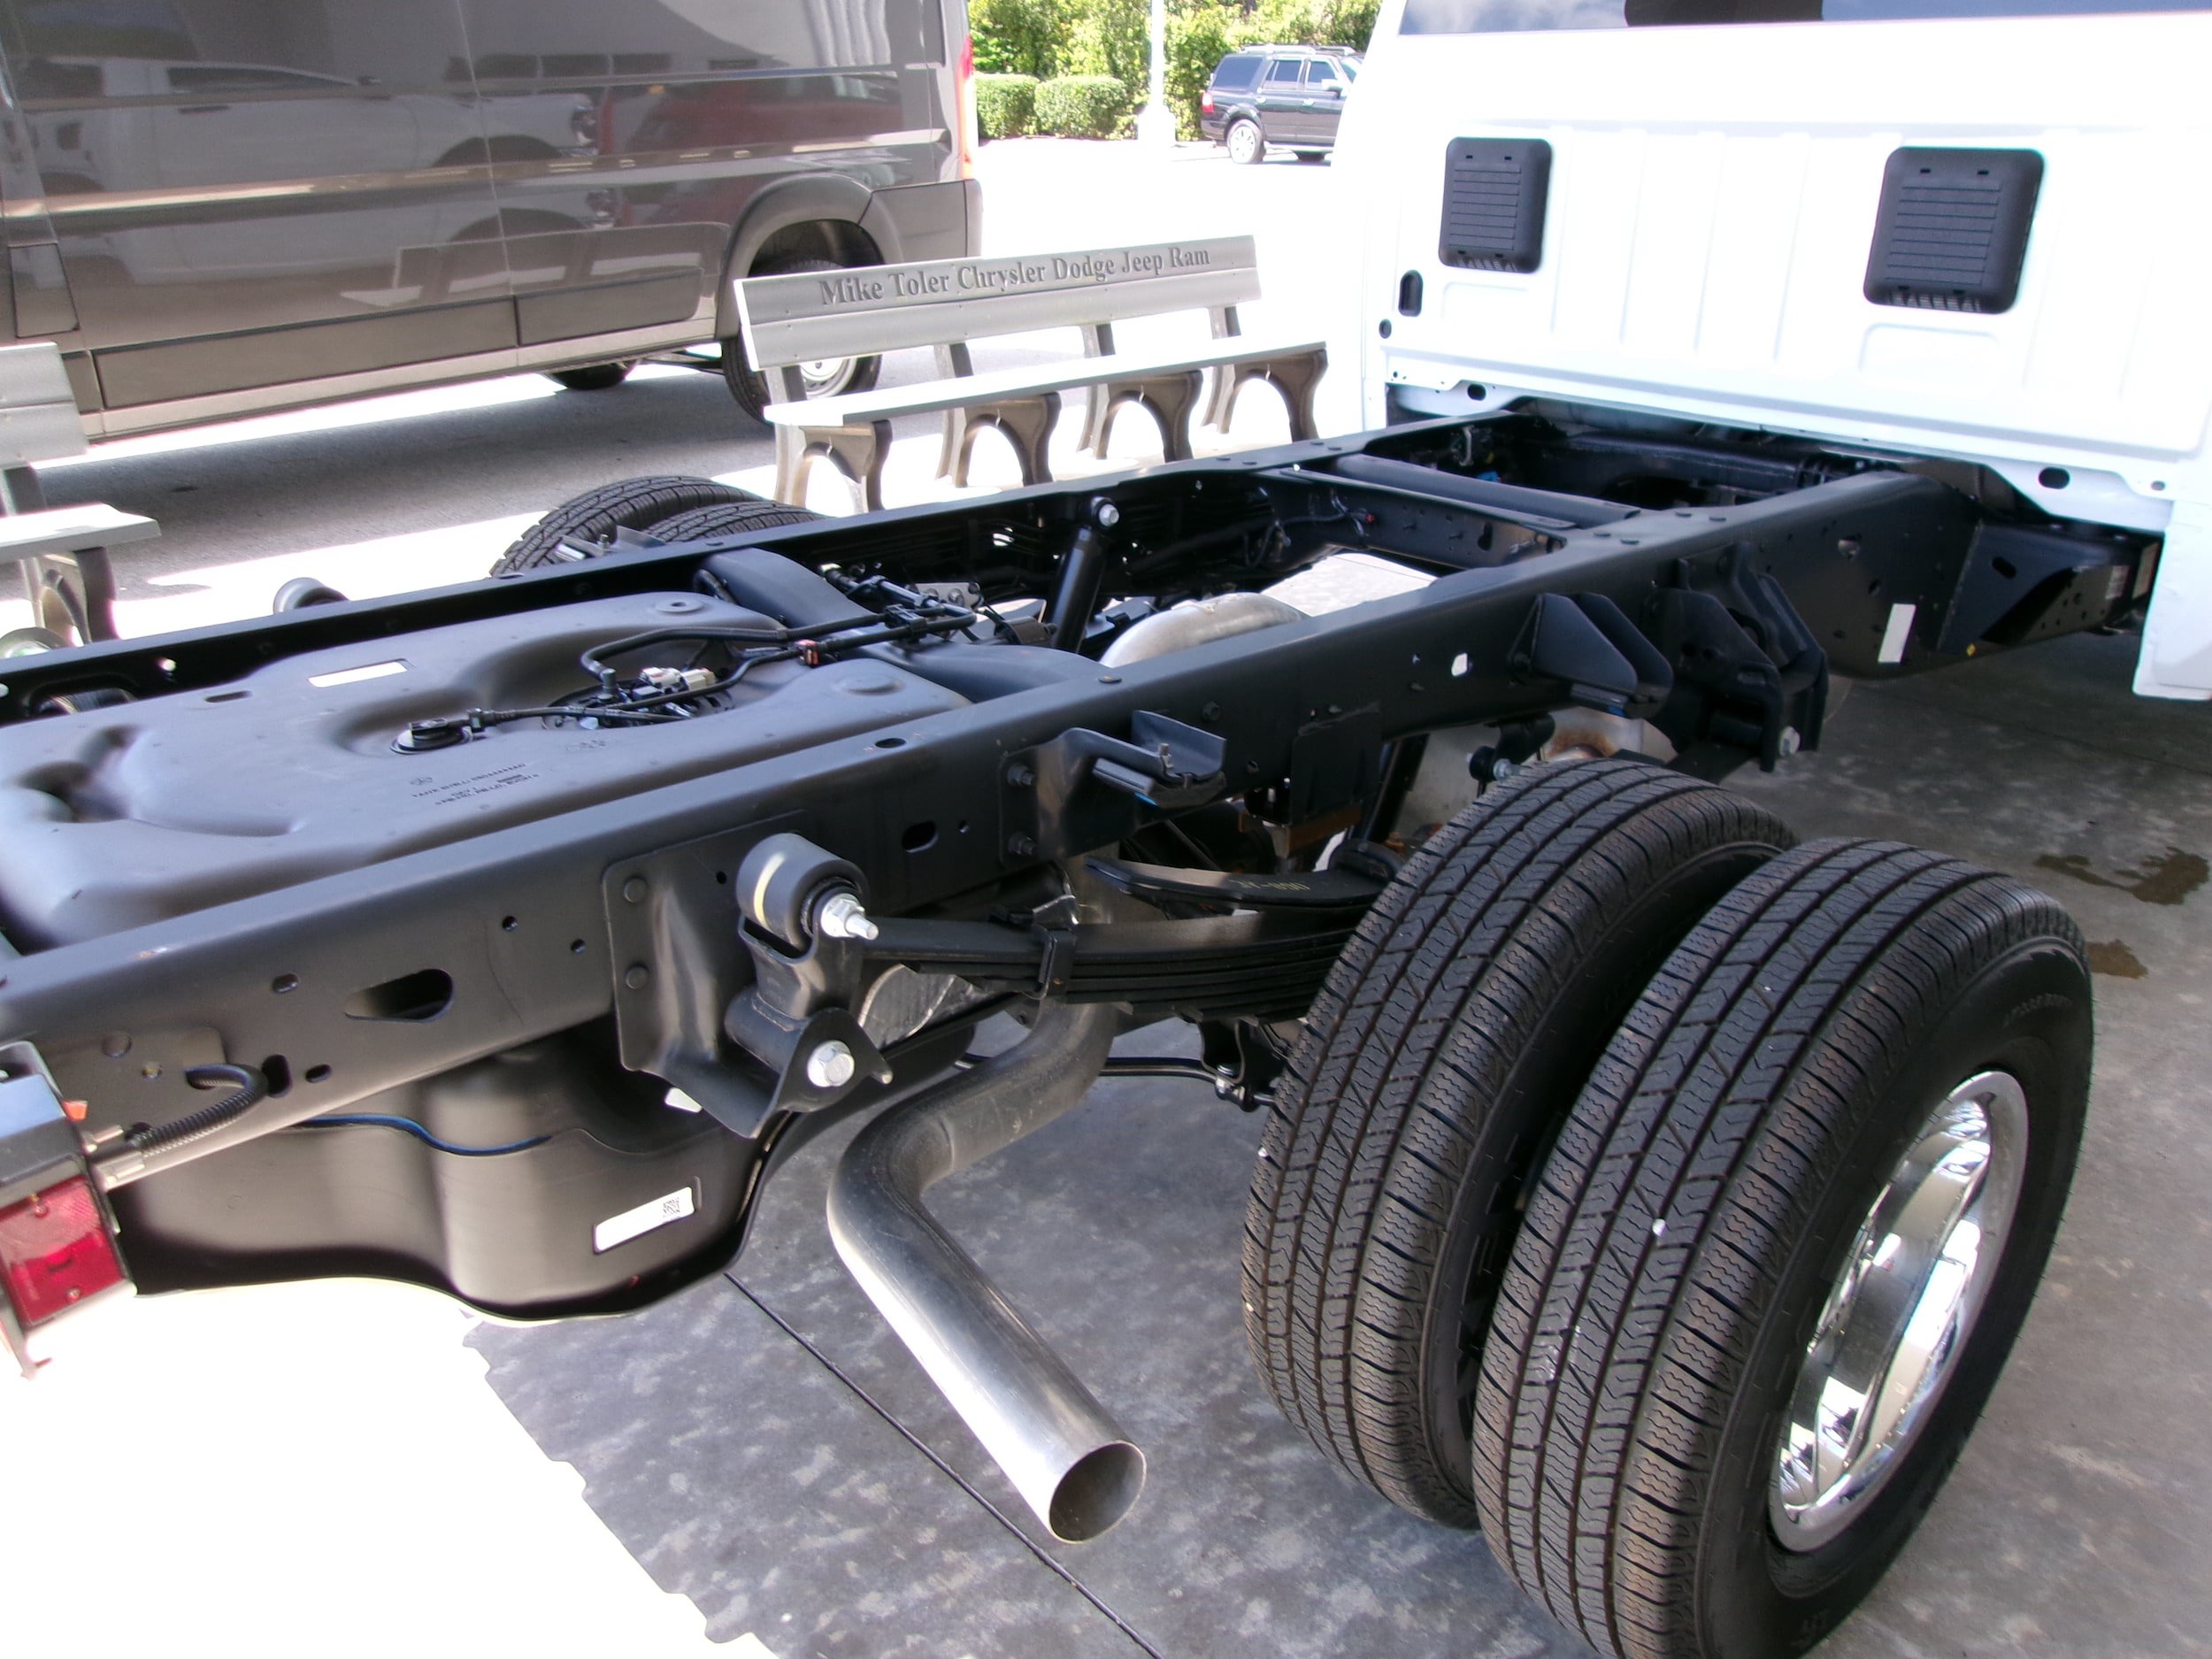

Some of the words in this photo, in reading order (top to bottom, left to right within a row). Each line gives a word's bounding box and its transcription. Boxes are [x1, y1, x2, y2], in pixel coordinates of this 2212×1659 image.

[819, 277, 883, 305] Mike
[888, 271, 950, 297] Toler
[957, 262, 1046, 292] Chrysler
[1052, 256, 1115, 282] Dodge
[1122, 251, 1163, 275] Jeep
[1168, 247, 1210, 268] Ram
